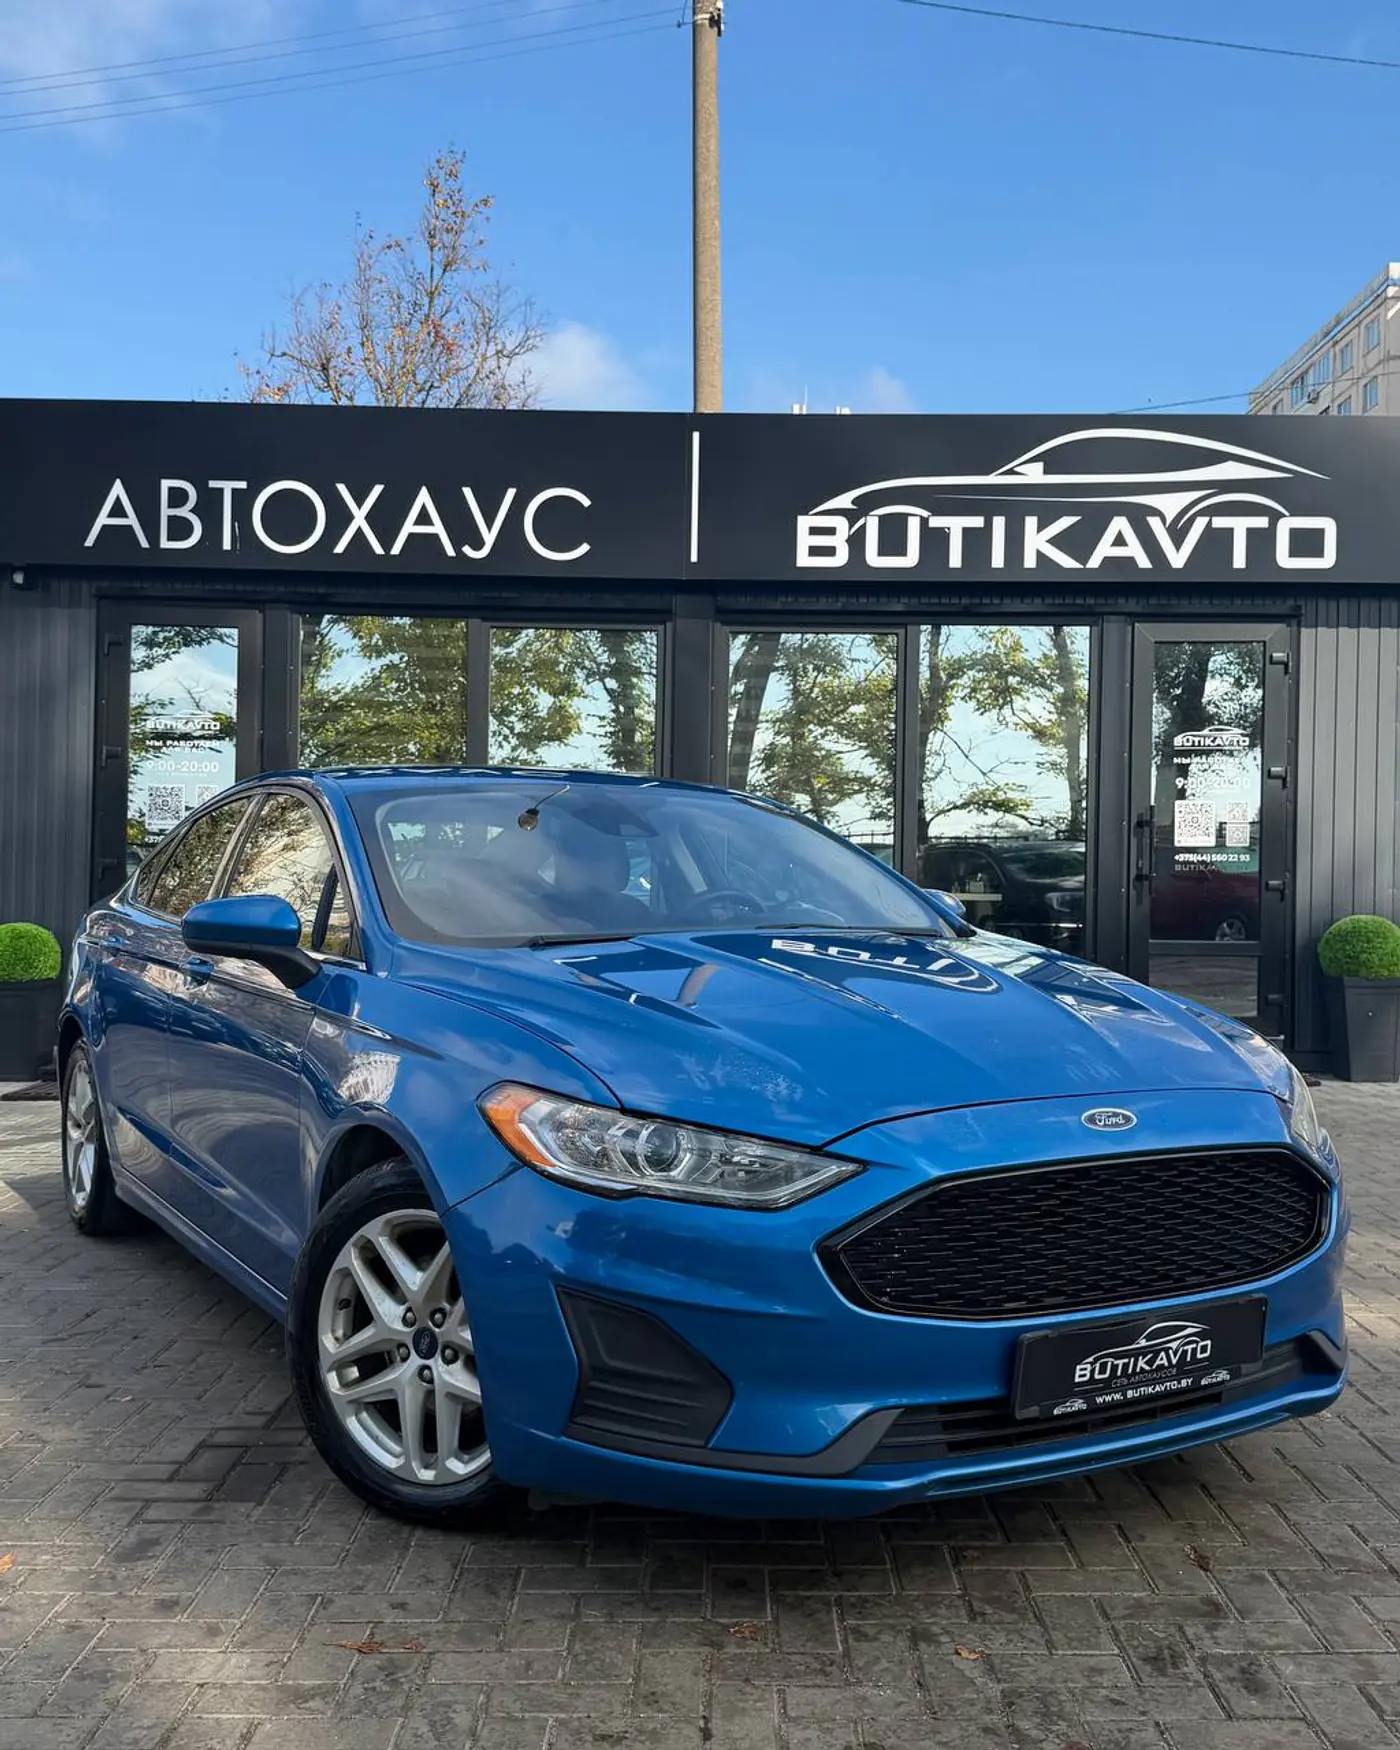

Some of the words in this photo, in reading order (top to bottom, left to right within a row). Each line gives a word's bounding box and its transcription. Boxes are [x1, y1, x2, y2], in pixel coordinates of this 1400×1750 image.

[84, 478, 592, 561] АВТОХАУС
[796, 515, 1337, 569] BUTIKAVTO
[146, 720, 220, 730] BUTIKAVTO
[1174, 736, 1249, 746] BUTIKAVTO
[146, 761, 219, 773] 9:00-20:00
[1095, 1112, 1125, 1126] Ford
[1074, 1340, 1211, 1383] BUTIKAVTO
[1127, 1377, 1193, 1398] BUTIKAVTO.BY
